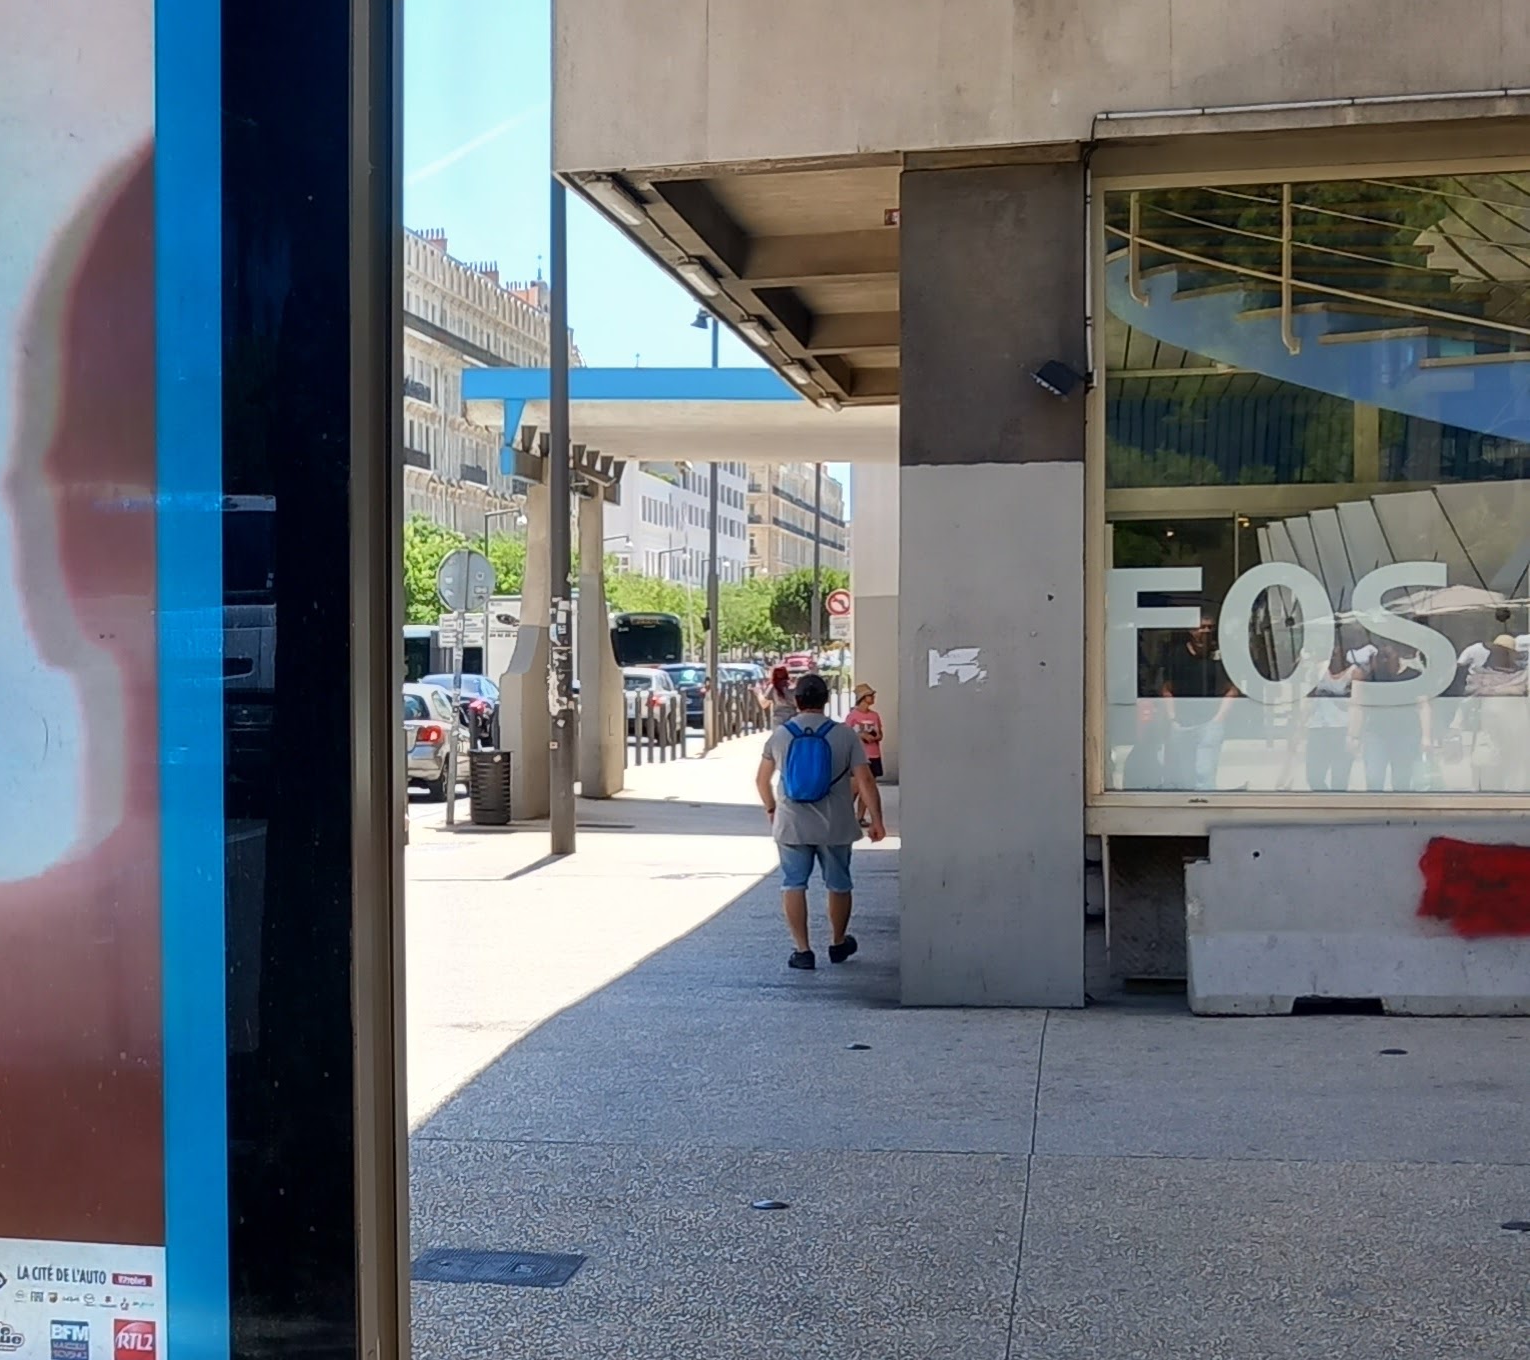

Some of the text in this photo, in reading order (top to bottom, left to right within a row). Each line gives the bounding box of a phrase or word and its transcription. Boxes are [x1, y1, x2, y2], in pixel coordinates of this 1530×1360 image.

[1105, 561, 1458, 708] FOS
[17, 1264, 107, 1285] LA CITÉ DE L'AUTO
[51, 1324, 89, 1341] BFM
[116, 1331, 154, 1351] RTL2
